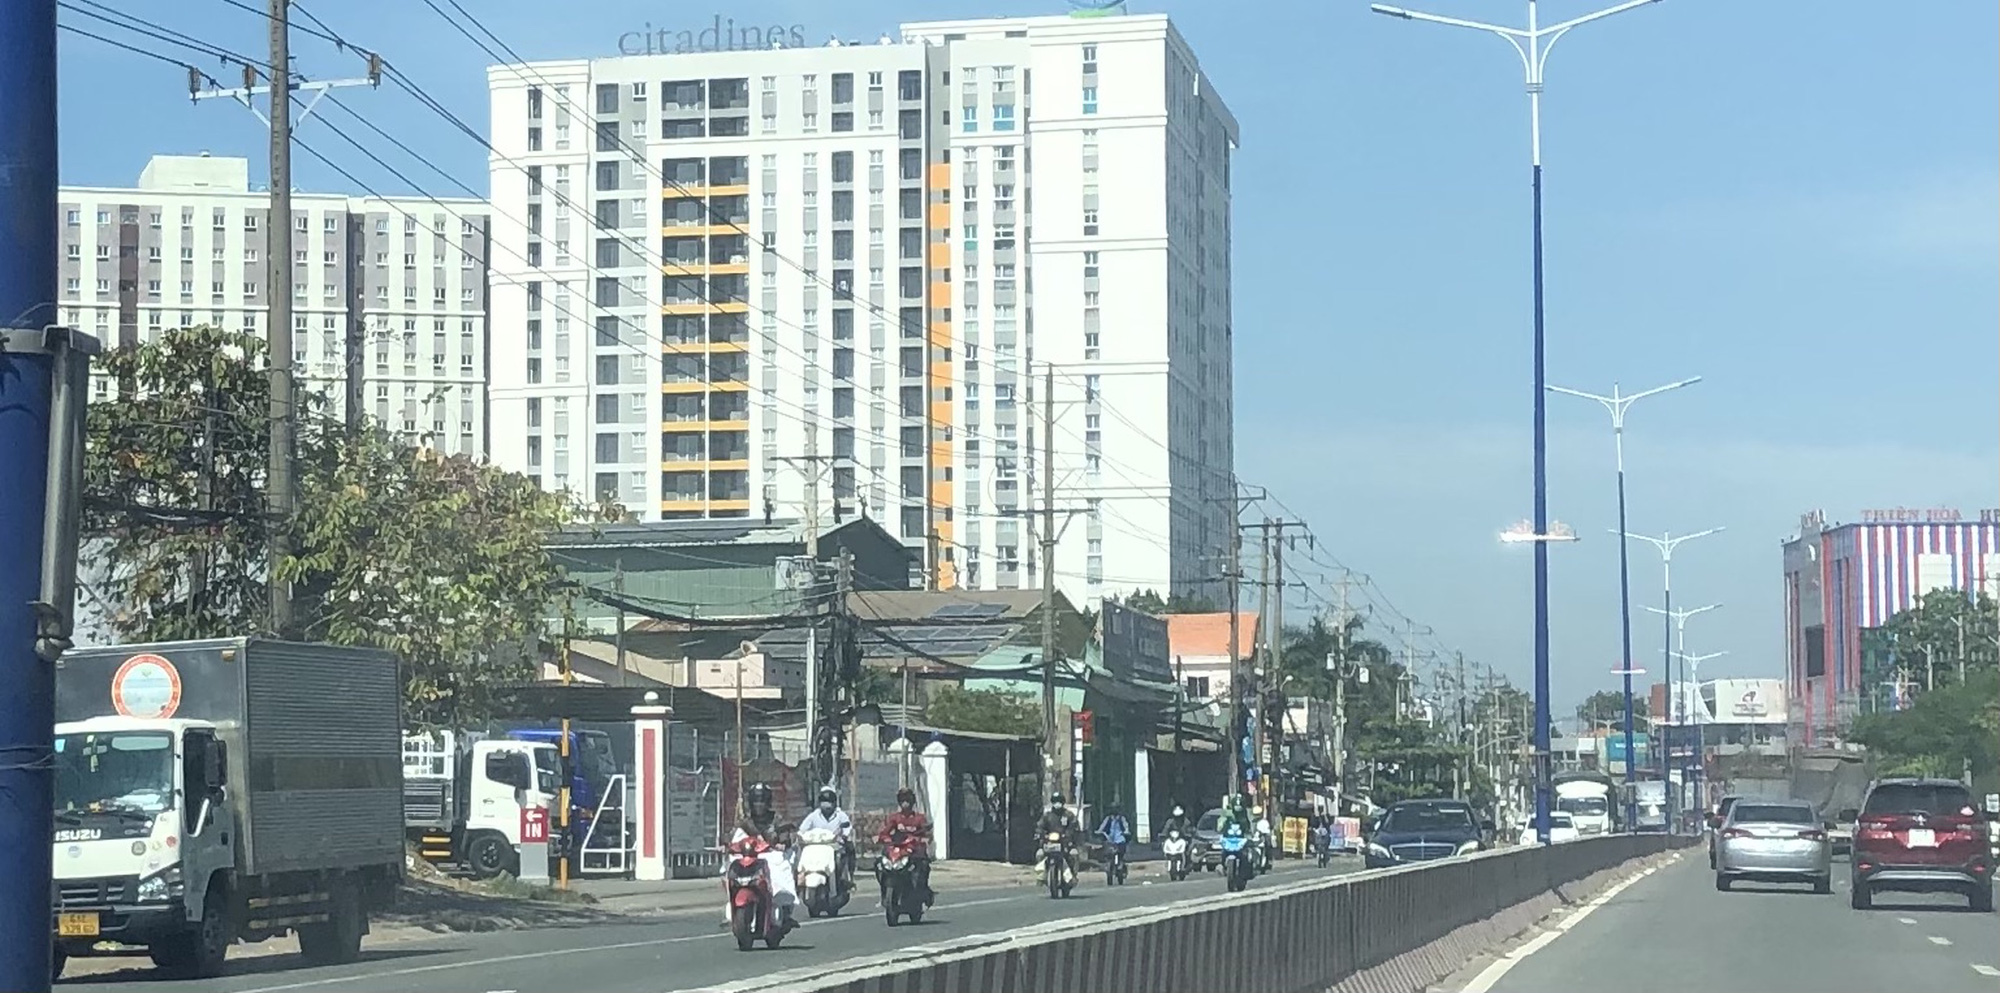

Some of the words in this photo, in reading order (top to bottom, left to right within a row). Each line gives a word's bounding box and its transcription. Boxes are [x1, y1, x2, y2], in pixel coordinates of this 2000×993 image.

[618, 14, 806, 56] citadines
[55, 829, 102, 841] ISUZU
[525, 823, 542, 838] IN
